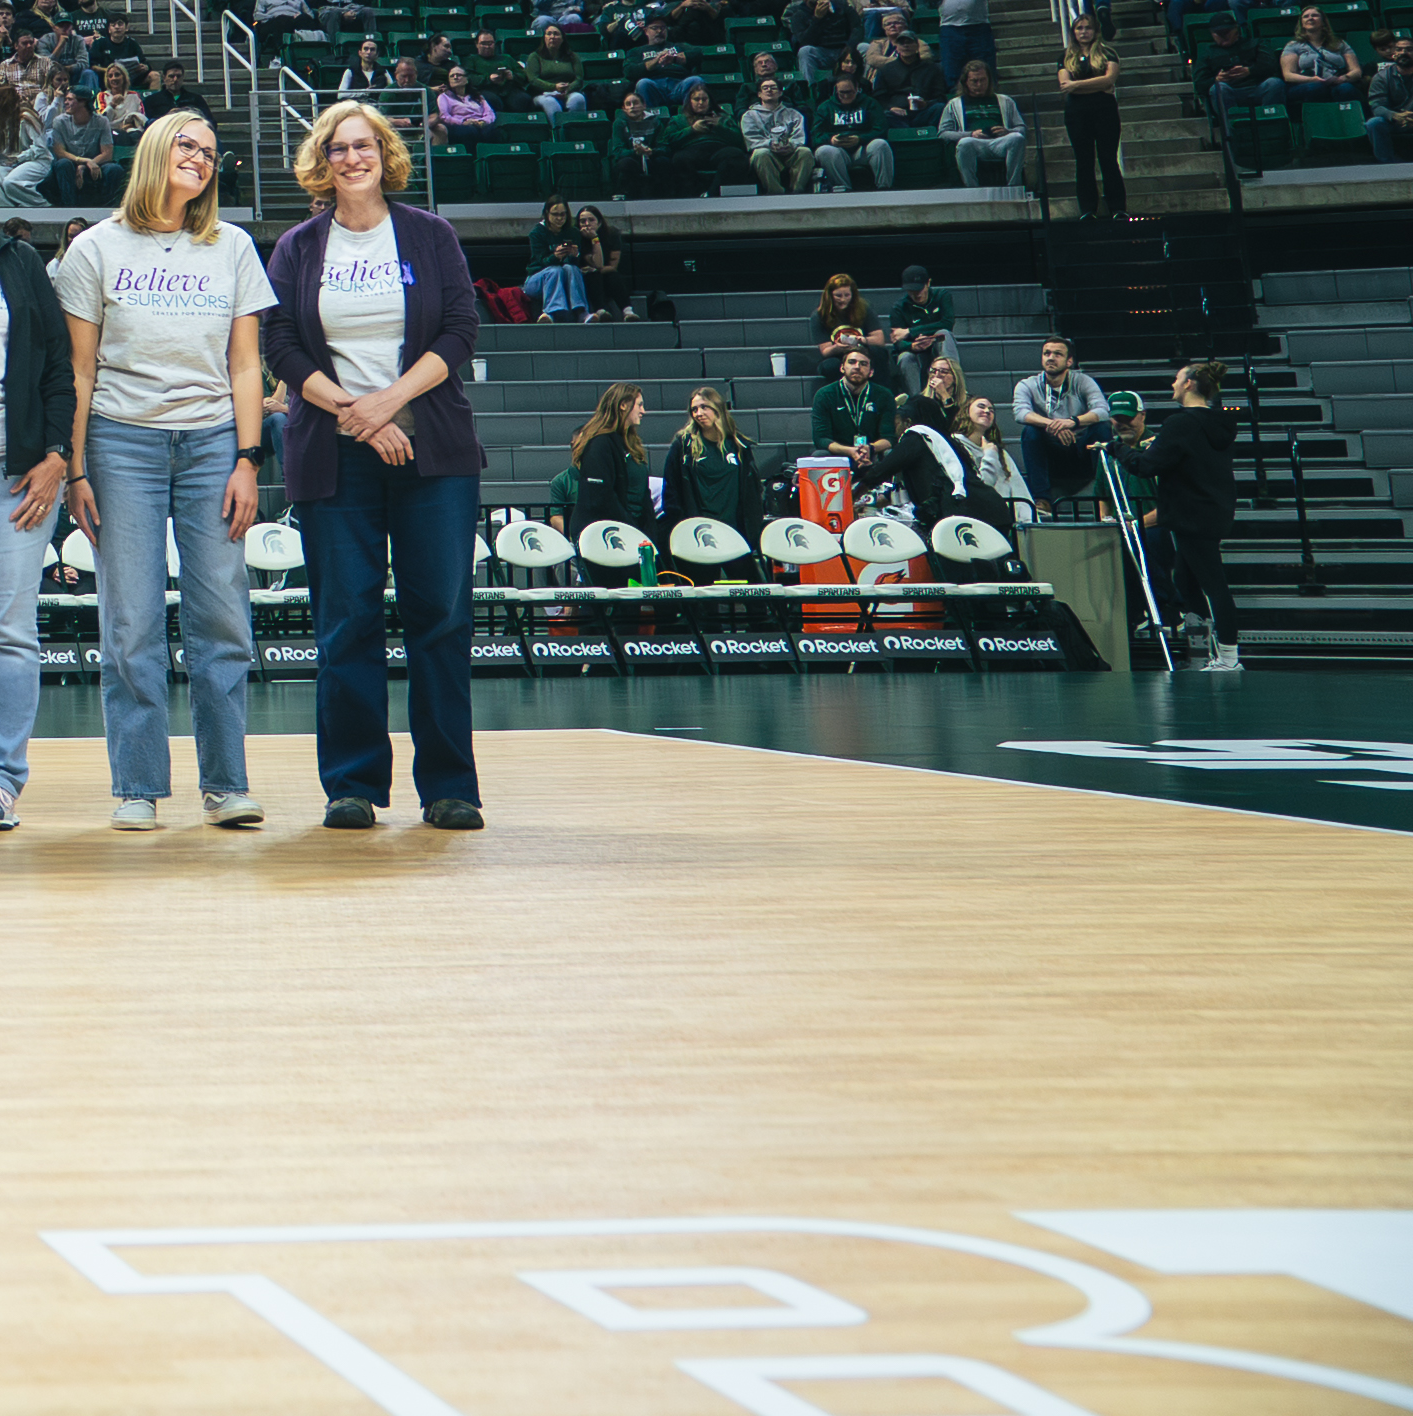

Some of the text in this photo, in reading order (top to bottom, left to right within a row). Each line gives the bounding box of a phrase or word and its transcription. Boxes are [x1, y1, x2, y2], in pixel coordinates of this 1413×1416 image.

[112, 267, 210, 292] Believe
[822, 472, 841, 493] G
[473, 591, 506, 600] ARTANS
[554, 591, 596, 600] SPARTANS
[642, 589, 683, 599] SPARTANS
[729, 587, 771, 597] SPARTANS
[817, 586, 861, 597] SPARTANS
[902, 586, 947, 597] SPARTANS
[998, 586, 1041, 596] SPARTANS
[470, 642, 522, 658] ocket
[548, 641, 611, 657] Rocket
[639, 640, 701, 656] Rocket
[726, 639, 789, 655] Rocket
[815, 638, 880, 654] Rocket
[901, 635, 966, 652] Rocket
[994, 636, 1058, 653] Rocket
[39, 649, 77, 665] cket
